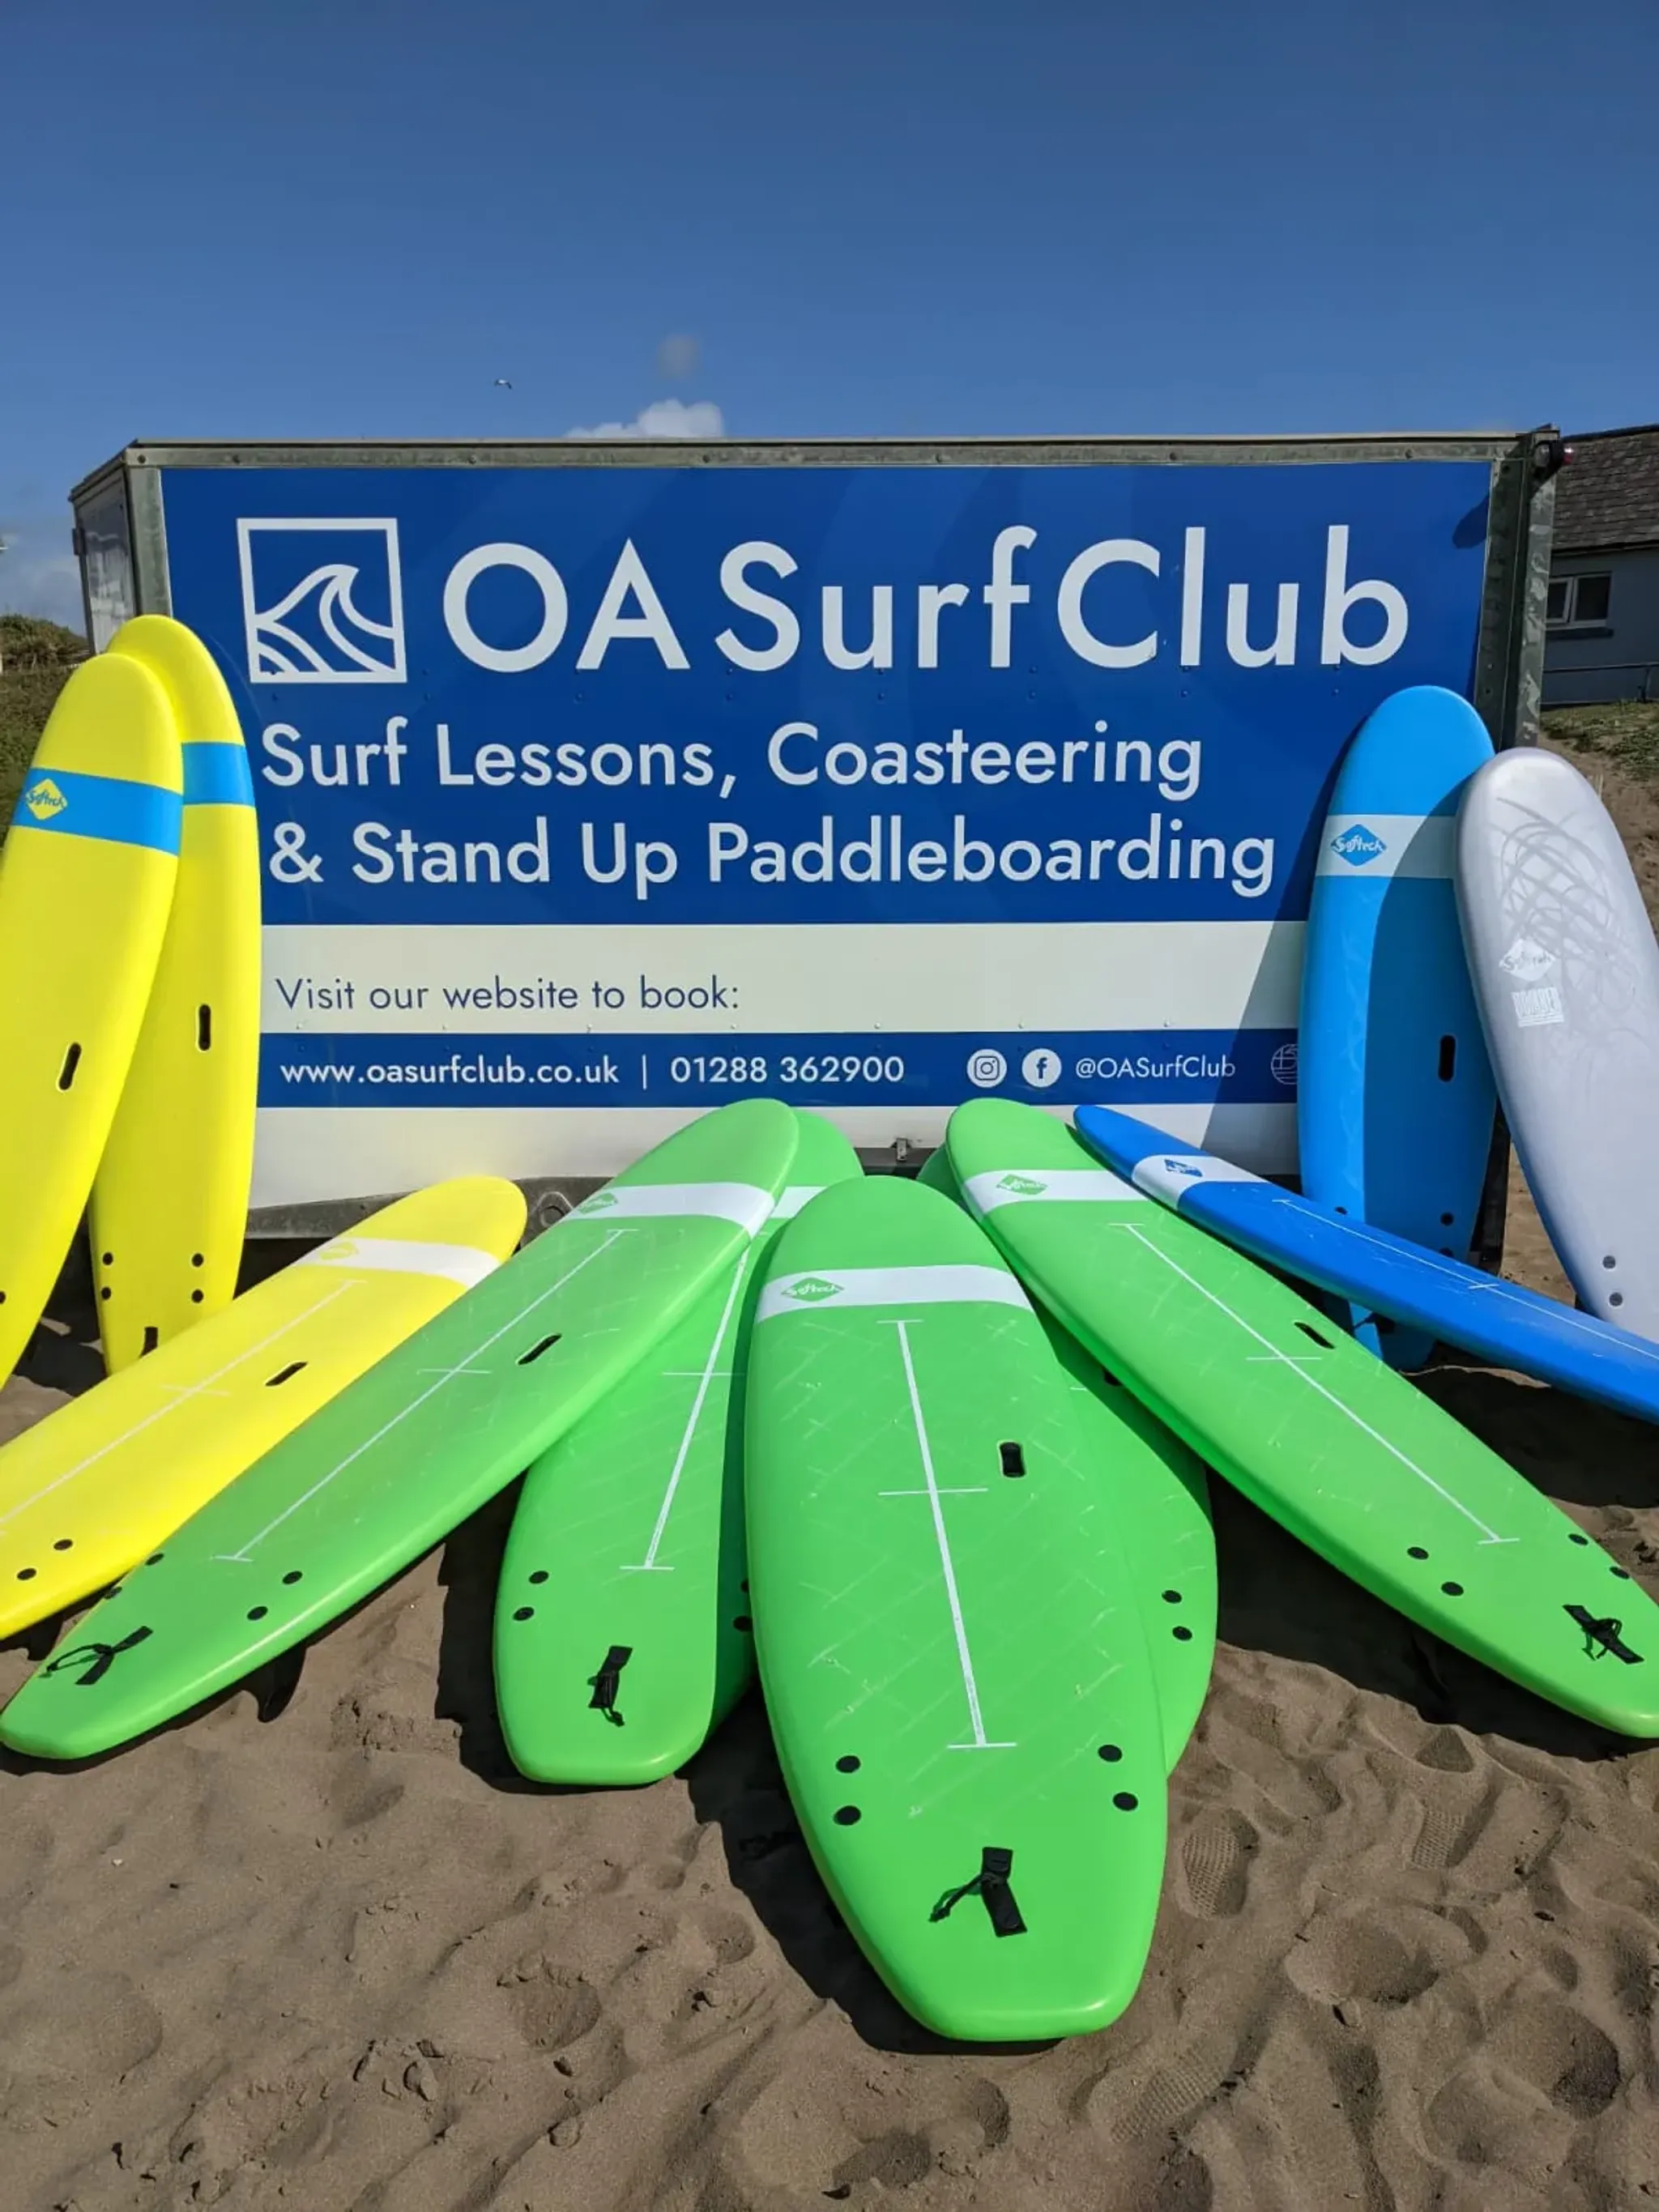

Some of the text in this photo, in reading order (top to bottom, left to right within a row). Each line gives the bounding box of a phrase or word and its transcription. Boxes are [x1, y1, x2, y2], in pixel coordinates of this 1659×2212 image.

[443, 539, 690, 672] OA
[262, 716, 1201, 801] Surf Lessons, Coasteering
[270, 812, 1274, 900] & Stand Up Paddleboarding
[275, 974, 739, 1009] Visit our website to book:
[280, 1055, 904, 1084] www.oasurfclub.co.uk 01288 362900
[1075, 1054, 1236, 1080] @OASurfClub
